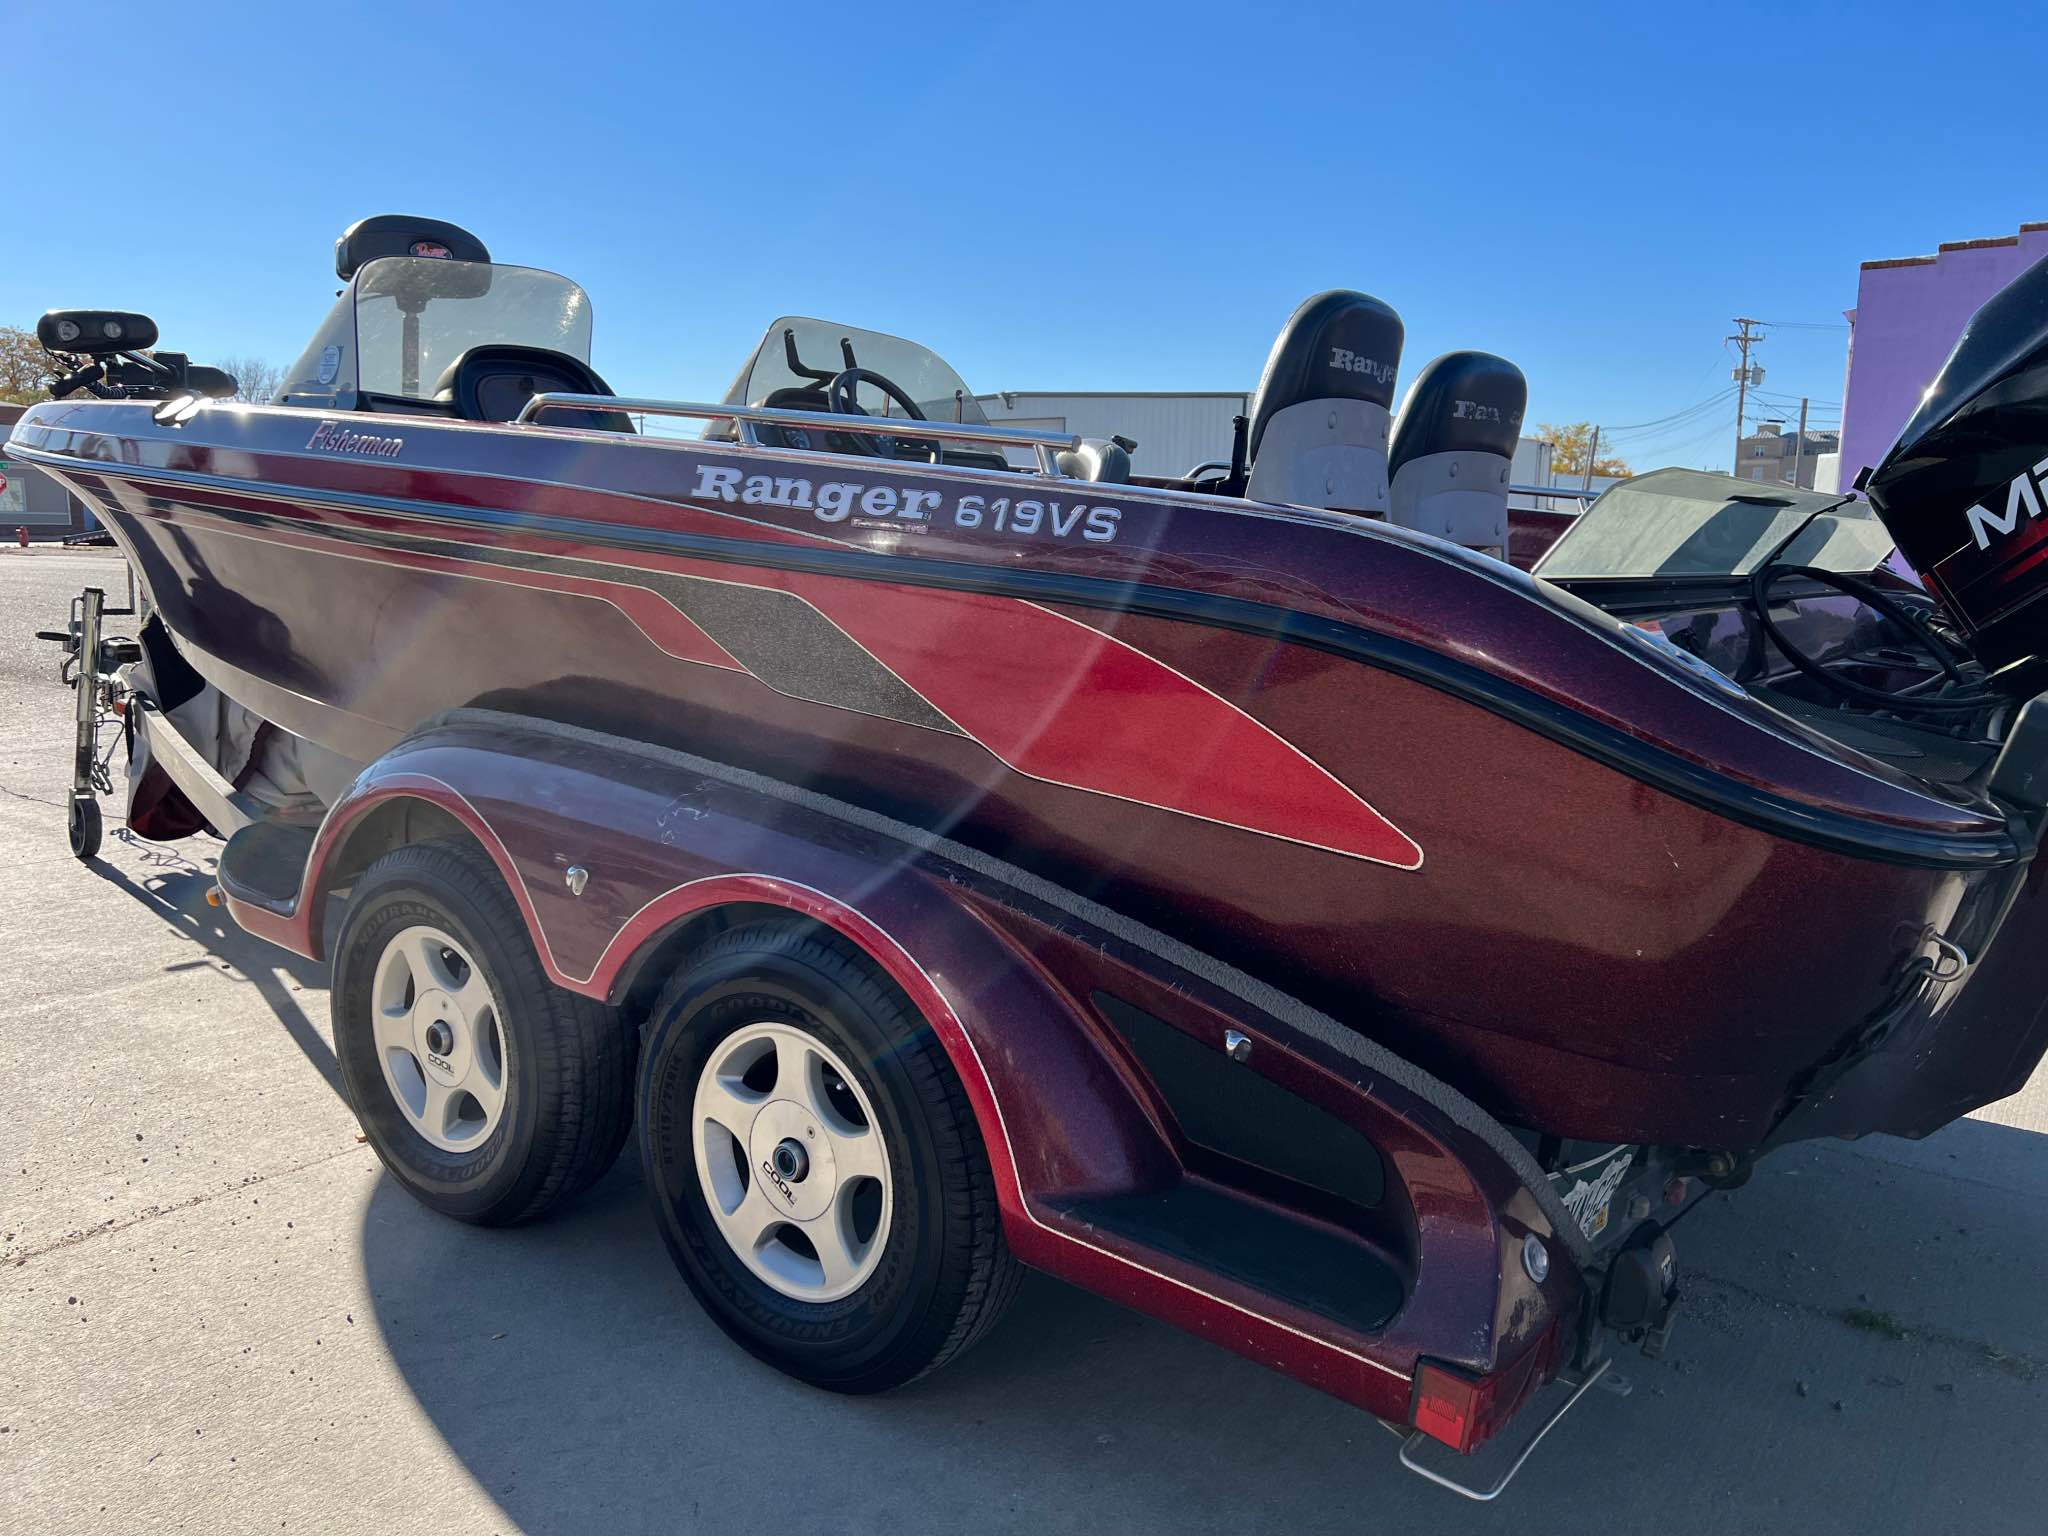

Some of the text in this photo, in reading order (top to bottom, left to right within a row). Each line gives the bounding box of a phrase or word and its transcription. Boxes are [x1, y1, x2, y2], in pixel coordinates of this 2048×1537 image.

[1329, 347, 1397, 385] Range
[1453, 400, 1521, 425] Ran
[305, 420, 404, 457] Fisherman
[691, 464, 1122, 542] Ranger 619VS
[427, 1053, 455, 1074] COOL
[762, 1160, 796, 1206] COOL
